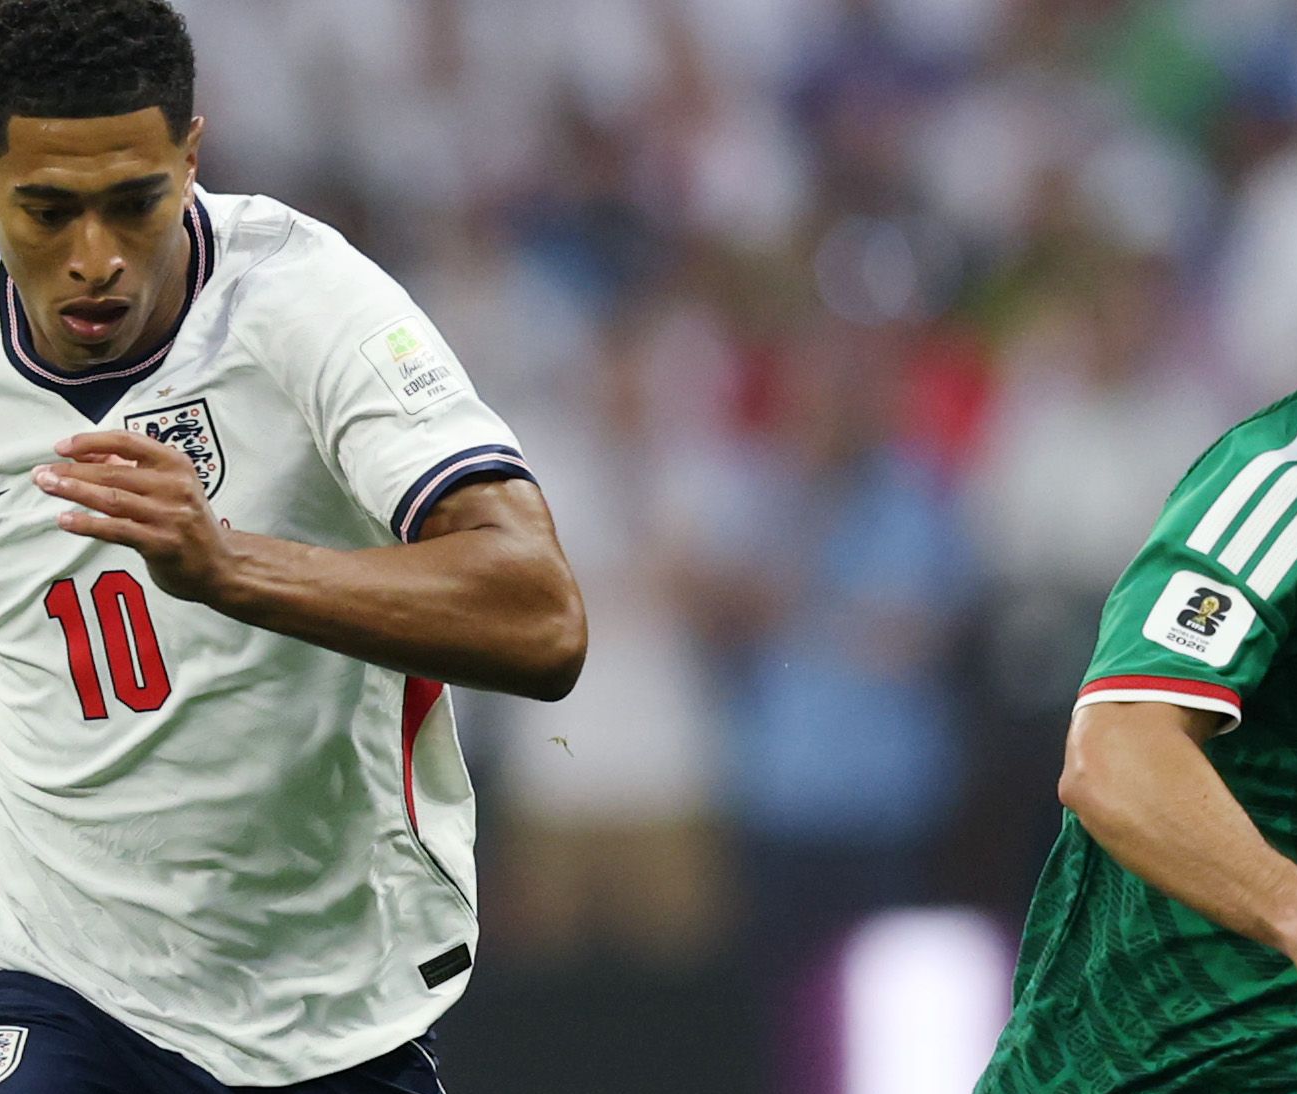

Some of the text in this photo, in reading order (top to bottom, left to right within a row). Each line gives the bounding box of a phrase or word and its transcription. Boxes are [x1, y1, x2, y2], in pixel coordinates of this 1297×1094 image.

[403, 365, 451, 397] EDUCATI
[427, 384, 446, 398] FIFA
[1185, 619, 1207, 634] FIFA
[44, 569, 172, 721] 10
[1166, 632, 1207, 654] 2026
